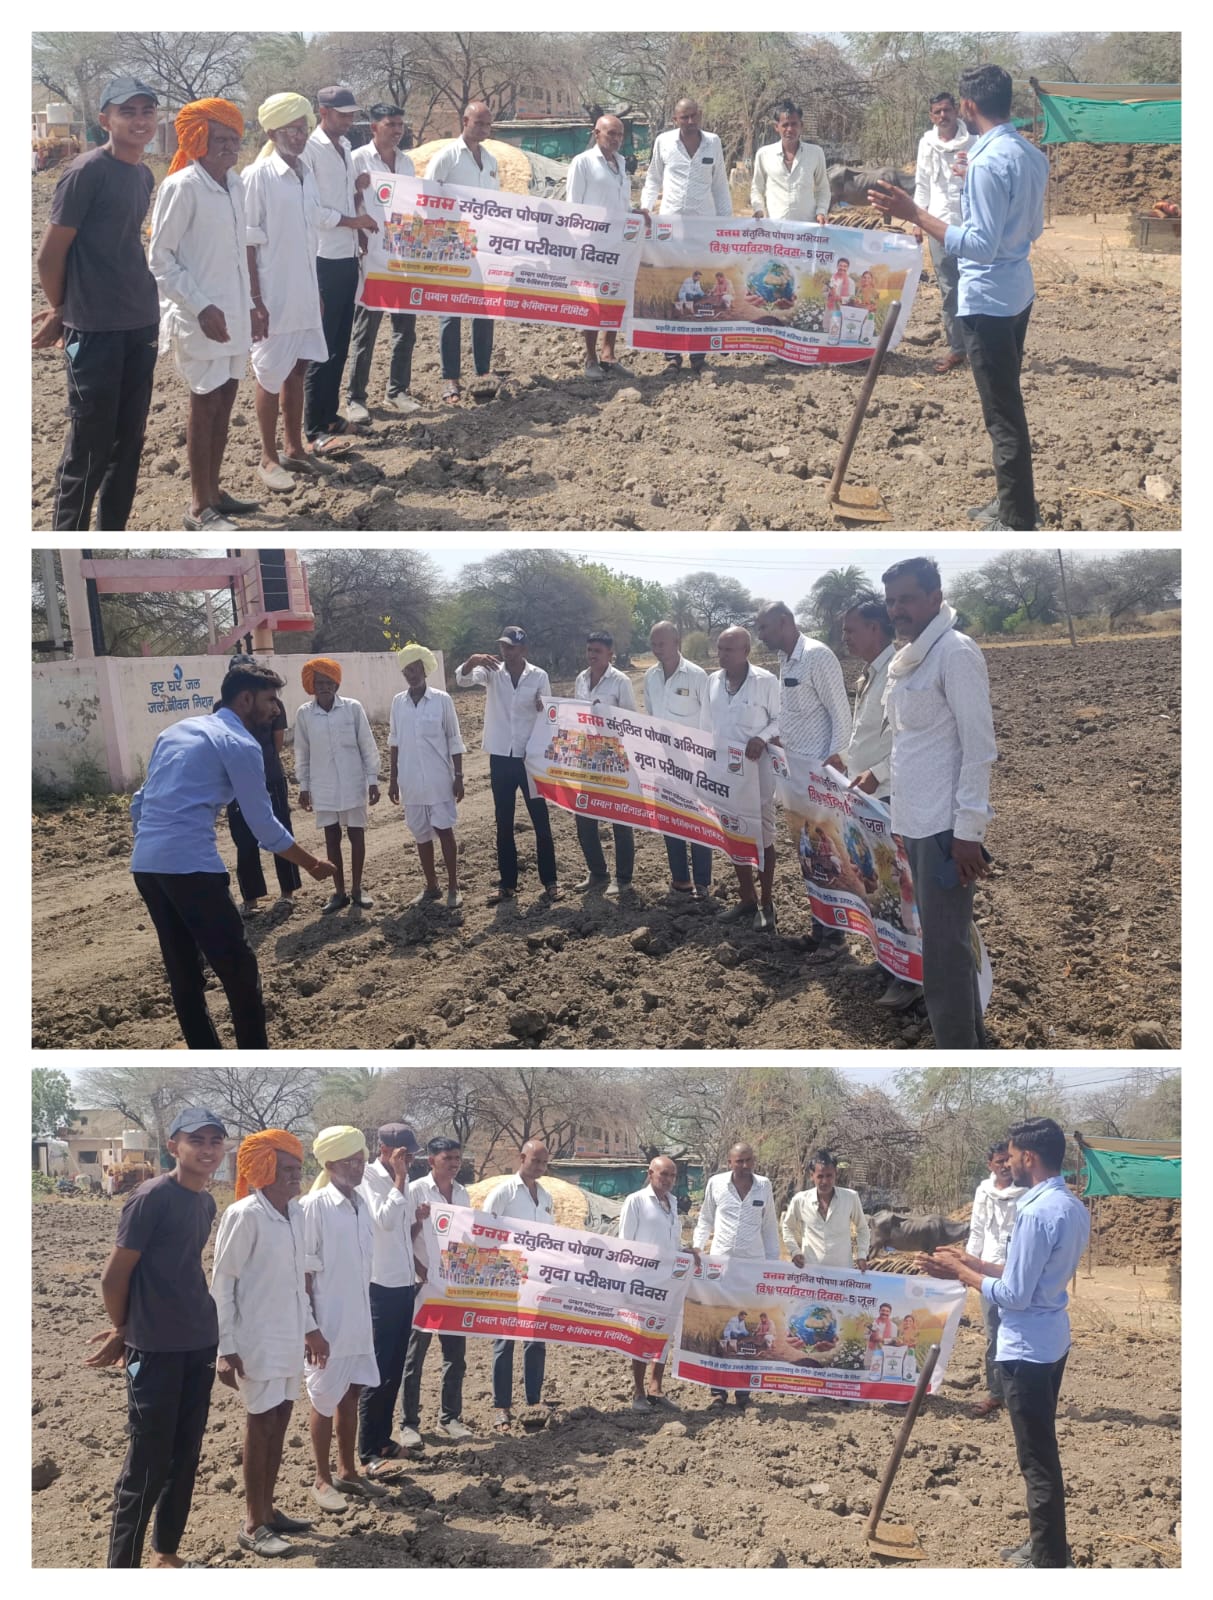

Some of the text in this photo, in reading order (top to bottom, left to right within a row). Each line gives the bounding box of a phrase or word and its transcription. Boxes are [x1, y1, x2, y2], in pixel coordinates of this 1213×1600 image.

[460, 199, 512, 219] संतुलित
[516, 204, 553, 225] पोषण
[555, 213, 611, 233] अभियान
[488, 233, 621, 265] मृदा परीक्षण दिवस
[742, 228, 771, 240] संतुलित
[772, 230, 795, 241] पोषण
[796, 232, 829, 244] अभियान
[709, 241, 729, 254] विश्व
[730, 242, 771, 254] पर्यावरण
[815, 250, 833, 262] जून
[150, 679, 200, 696] हर घर जल
[147, 702, 165, 713] जल
[606, 716, 642, 737] संतुलित
[644, 726, 672, 746] पोषण
[673, 737, 717, 761] अभियान
[634, 751, 656, 770] मृदा
[659, 757, 693, 784] परीक्षण
[696, 771, 730, 798] दिवस
[513, 1229, 565, 1252] संतुलित
[567, 1236, 604, 1259] पोषण
[605, 1245, 660, 1270] अभियान
[539, 1264, 668, 1301] मृदा परीक्षण दिवस
[787, 1271, 815, 1285] संतुलित
[816, 1275, 838, 1288] पोषण
[839, 1278, 872, 1290] अभियान
[756, 1283, 774, 1296] विश्व
[775, 1284, 816, 1298] पर्यावरण
[857, 1294, 876, 1307] जून
